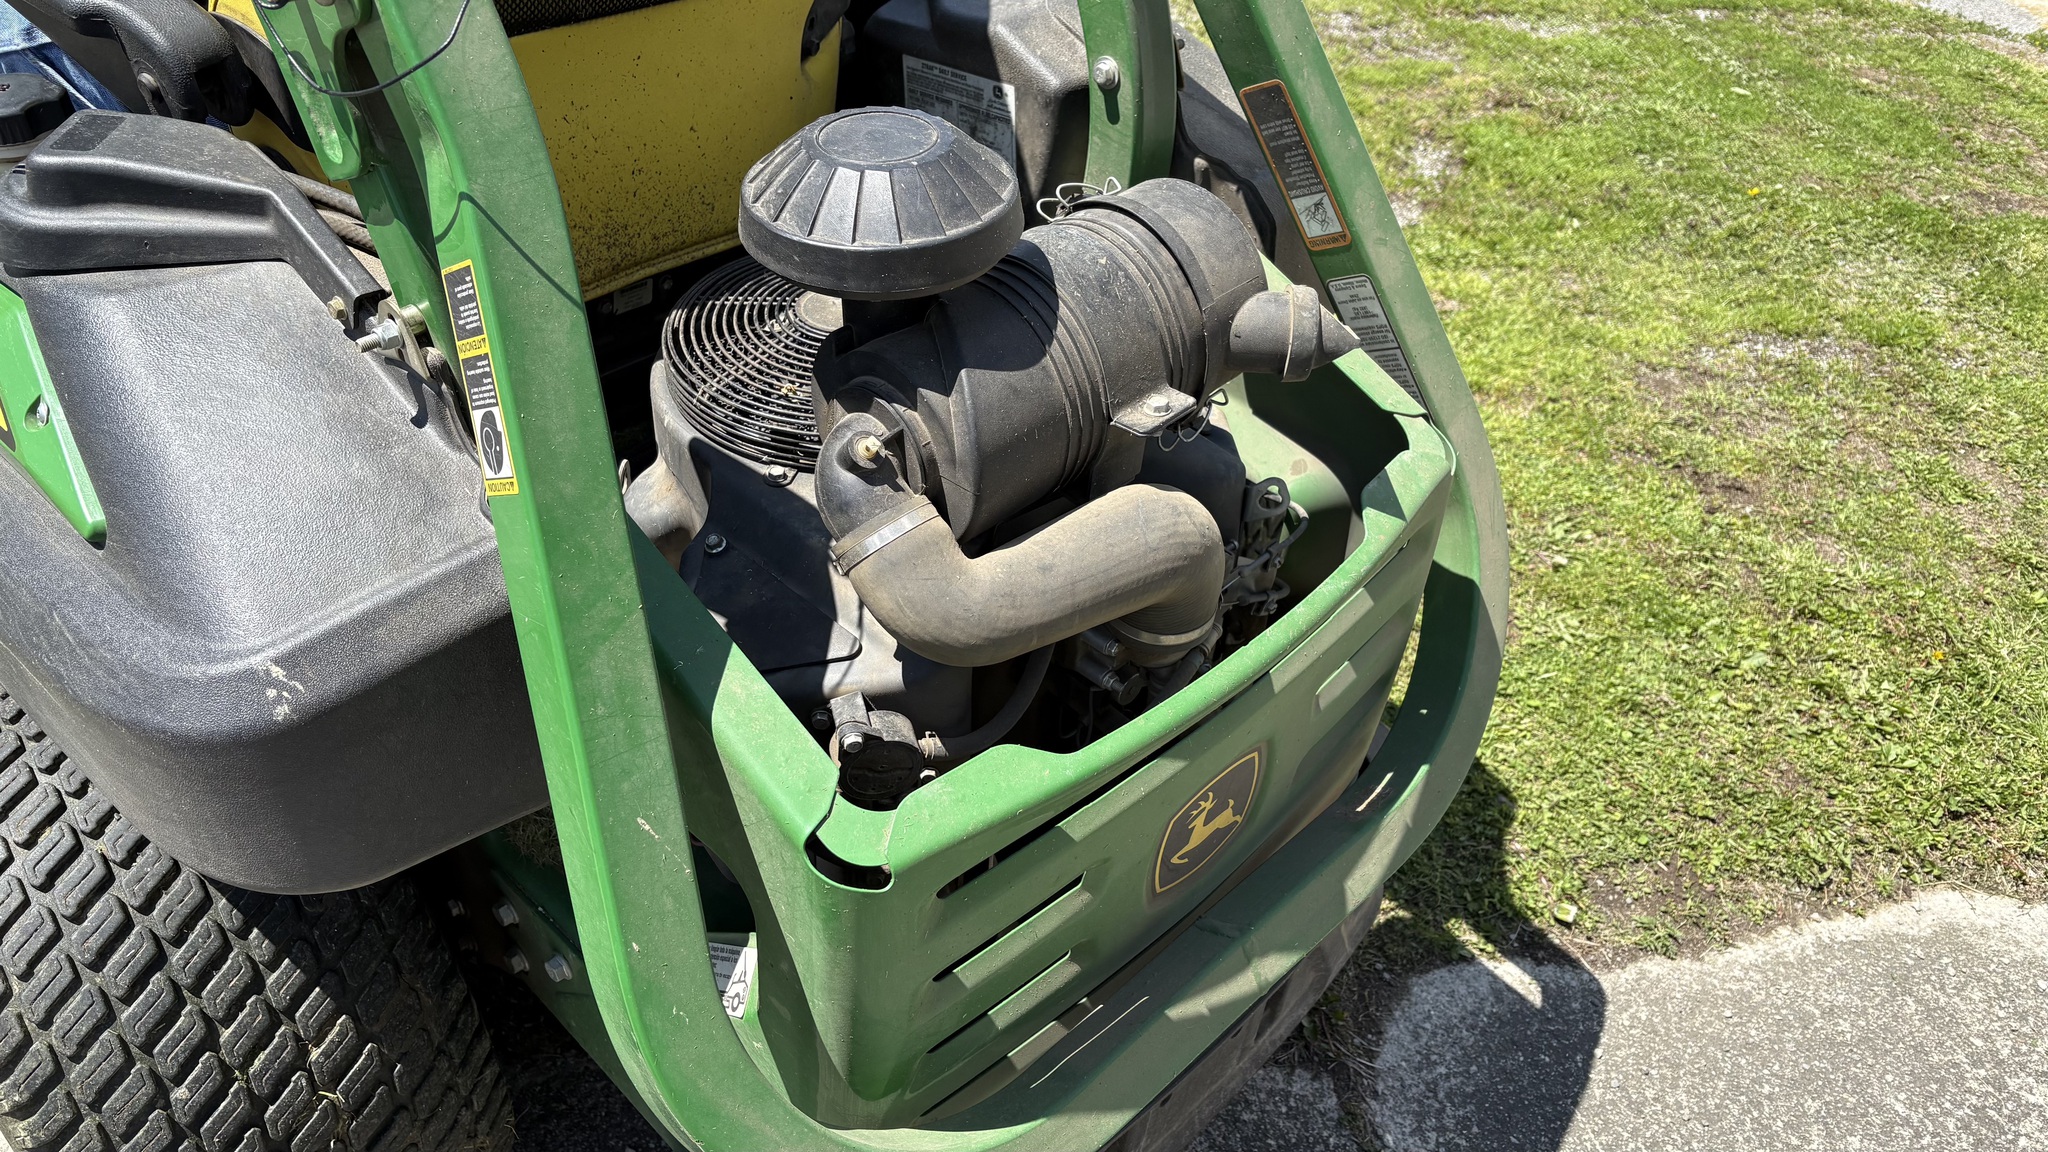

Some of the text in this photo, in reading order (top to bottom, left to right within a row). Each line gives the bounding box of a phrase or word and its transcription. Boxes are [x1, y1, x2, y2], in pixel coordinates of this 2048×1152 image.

[1288, 187, 1310, 197] CRUSHING
[1309, 236, 1341, 248] WARNING
[458, 339, 482, 355] ATENCIÓN
[488, 482, 511, 492] CAUTION
